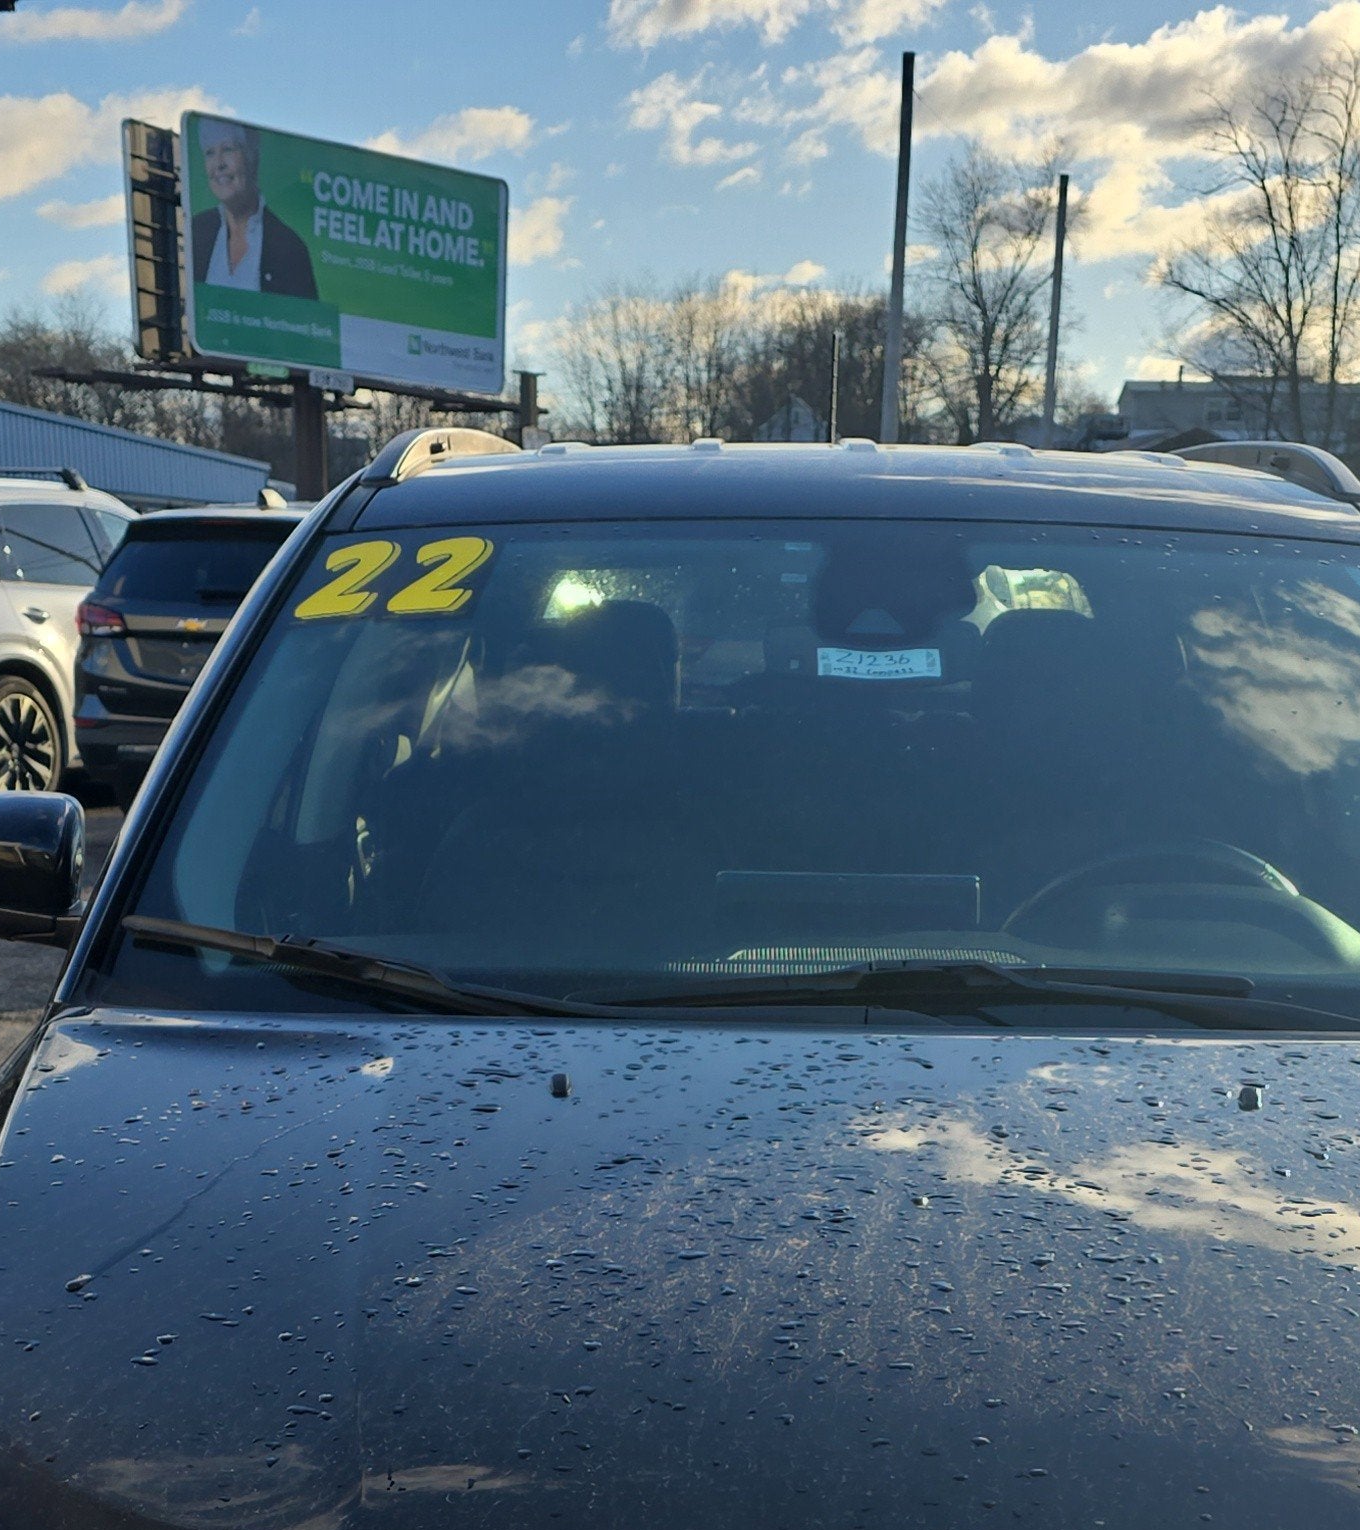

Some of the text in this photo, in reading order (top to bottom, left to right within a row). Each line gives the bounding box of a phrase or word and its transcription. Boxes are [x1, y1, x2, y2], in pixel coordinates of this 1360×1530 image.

[313, 206, 372, 246] FEEL
[375, 219, 405, 251] AT
[393, 188, 420, 221] IN
[423, 195, 475, 230] AND
[294, 536, 494, 620] 22
